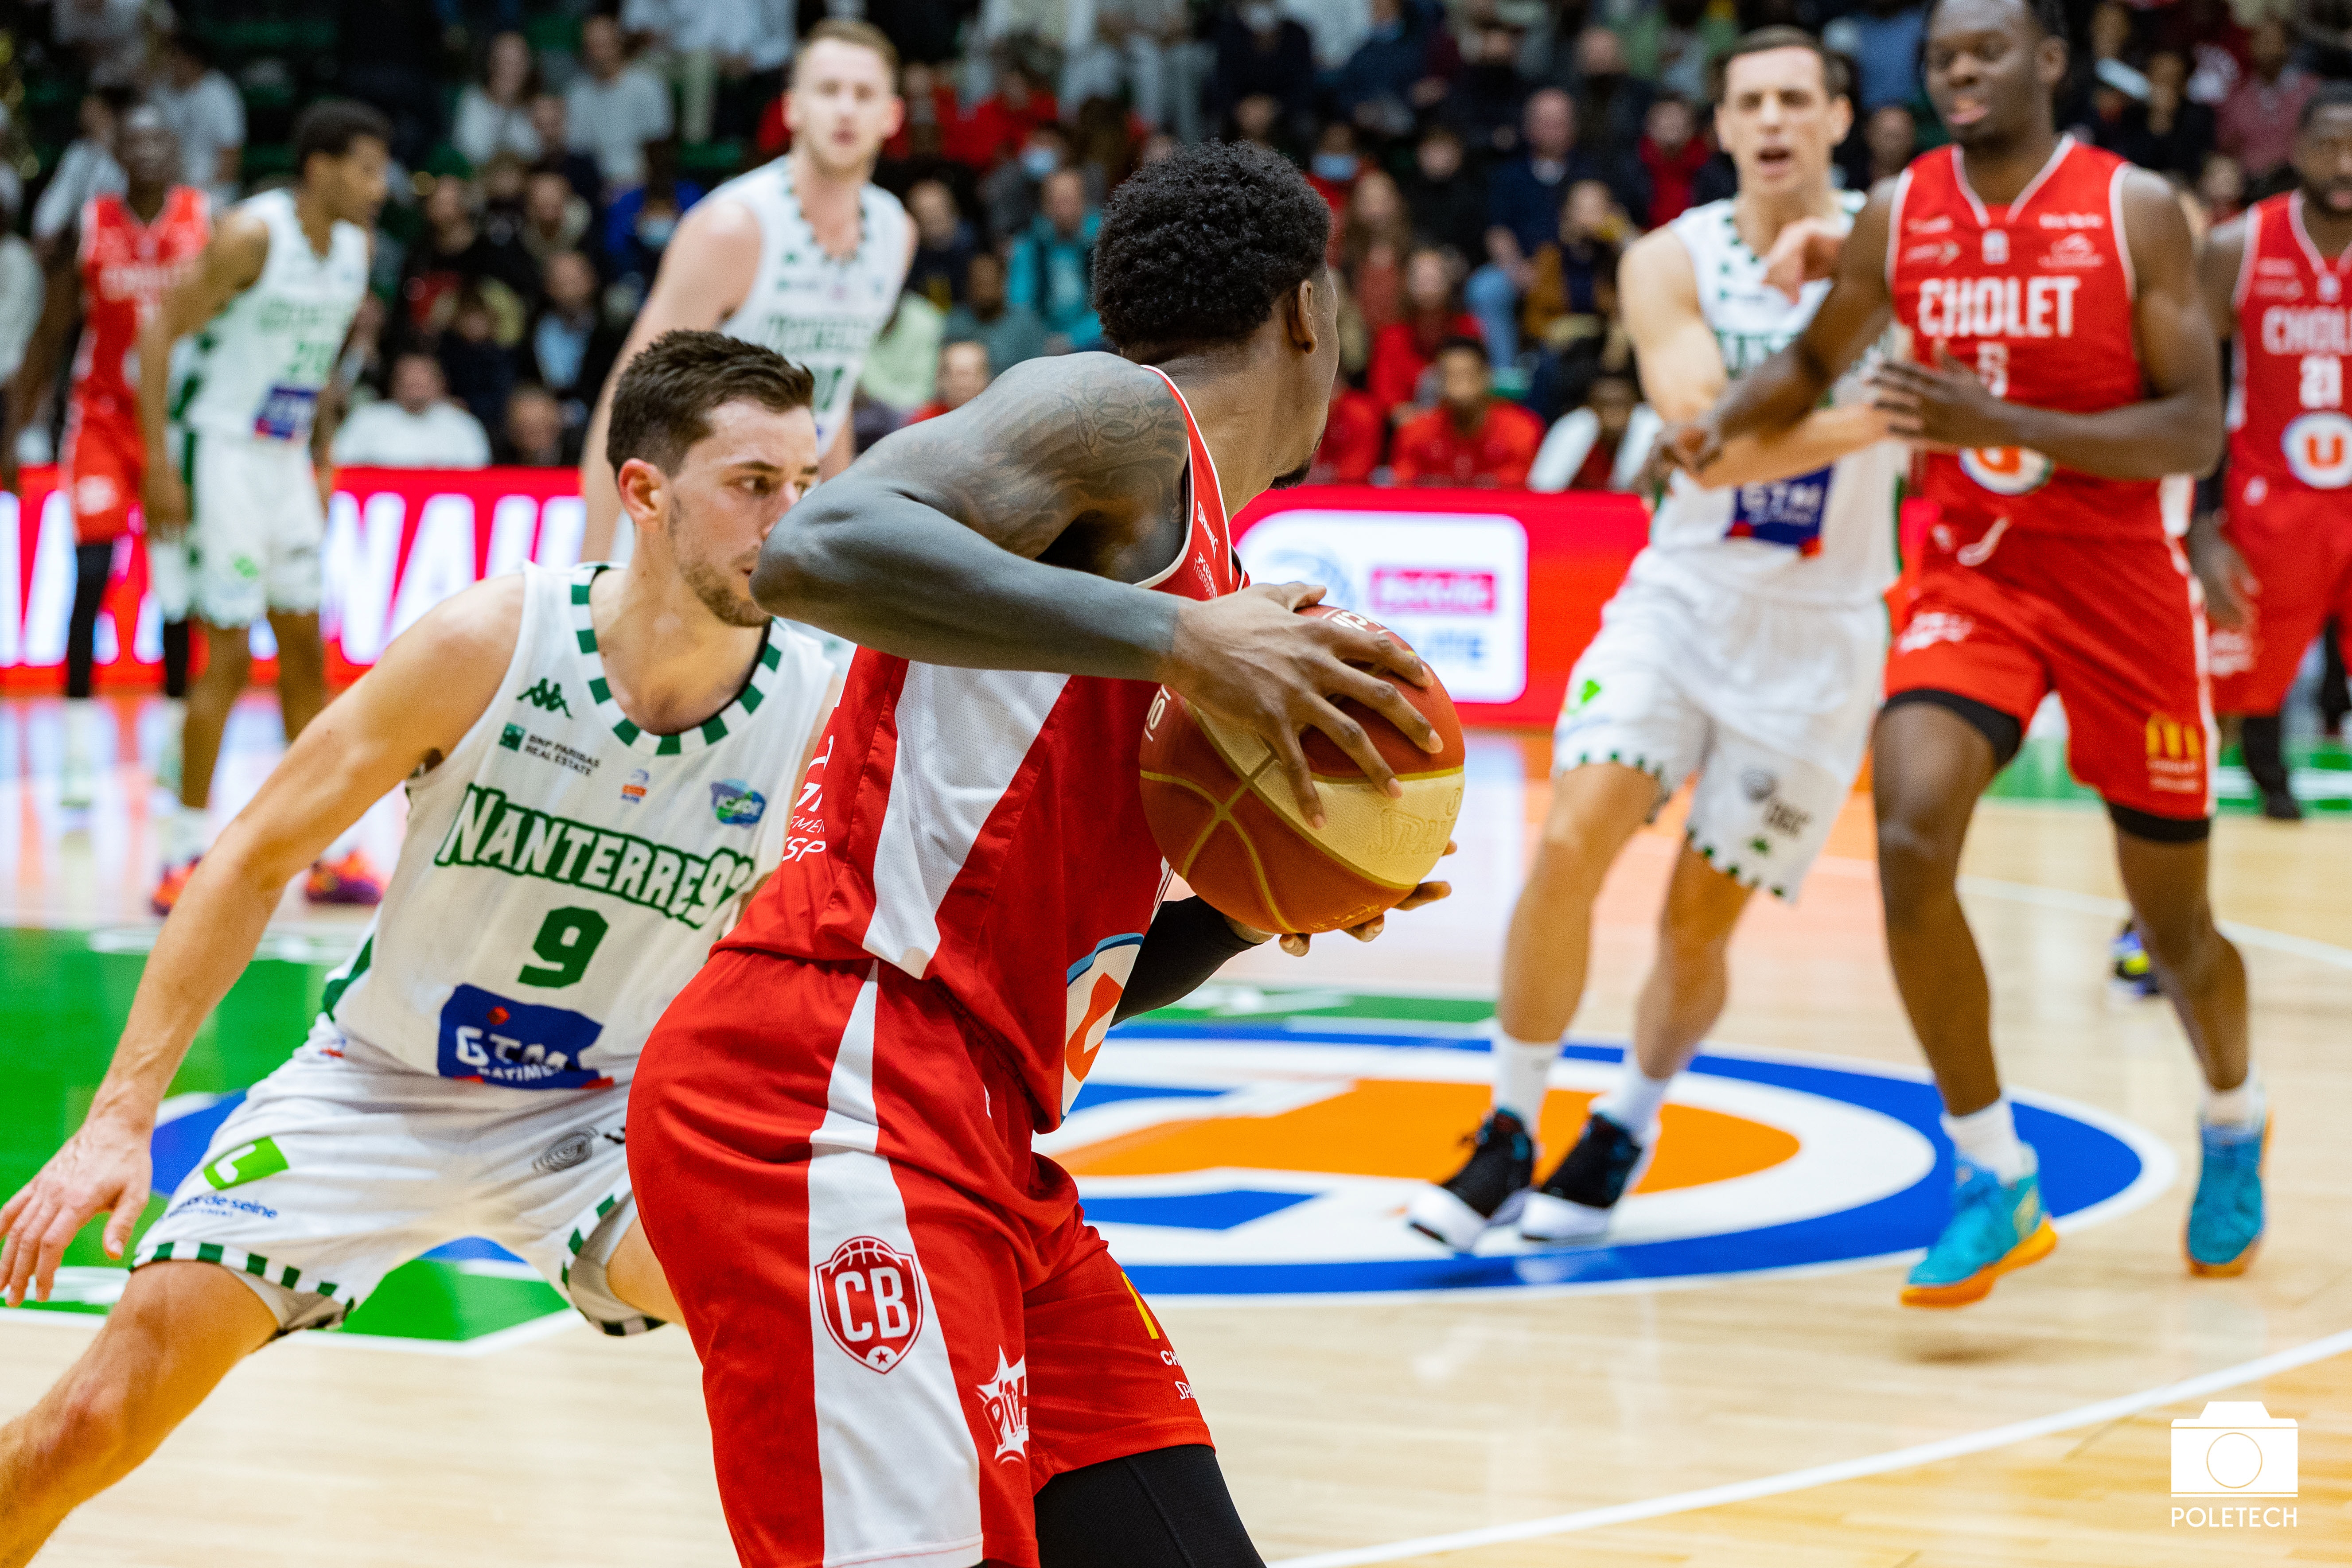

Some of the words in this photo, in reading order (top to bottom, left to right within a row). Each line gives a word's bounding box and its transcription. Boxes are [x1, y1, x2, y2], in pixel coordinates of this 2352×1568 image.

[1917, 276, 2081, 338] CHOLET
[517, 906, 609, 989] 9
[834, 1266, 911, 1342] CB
